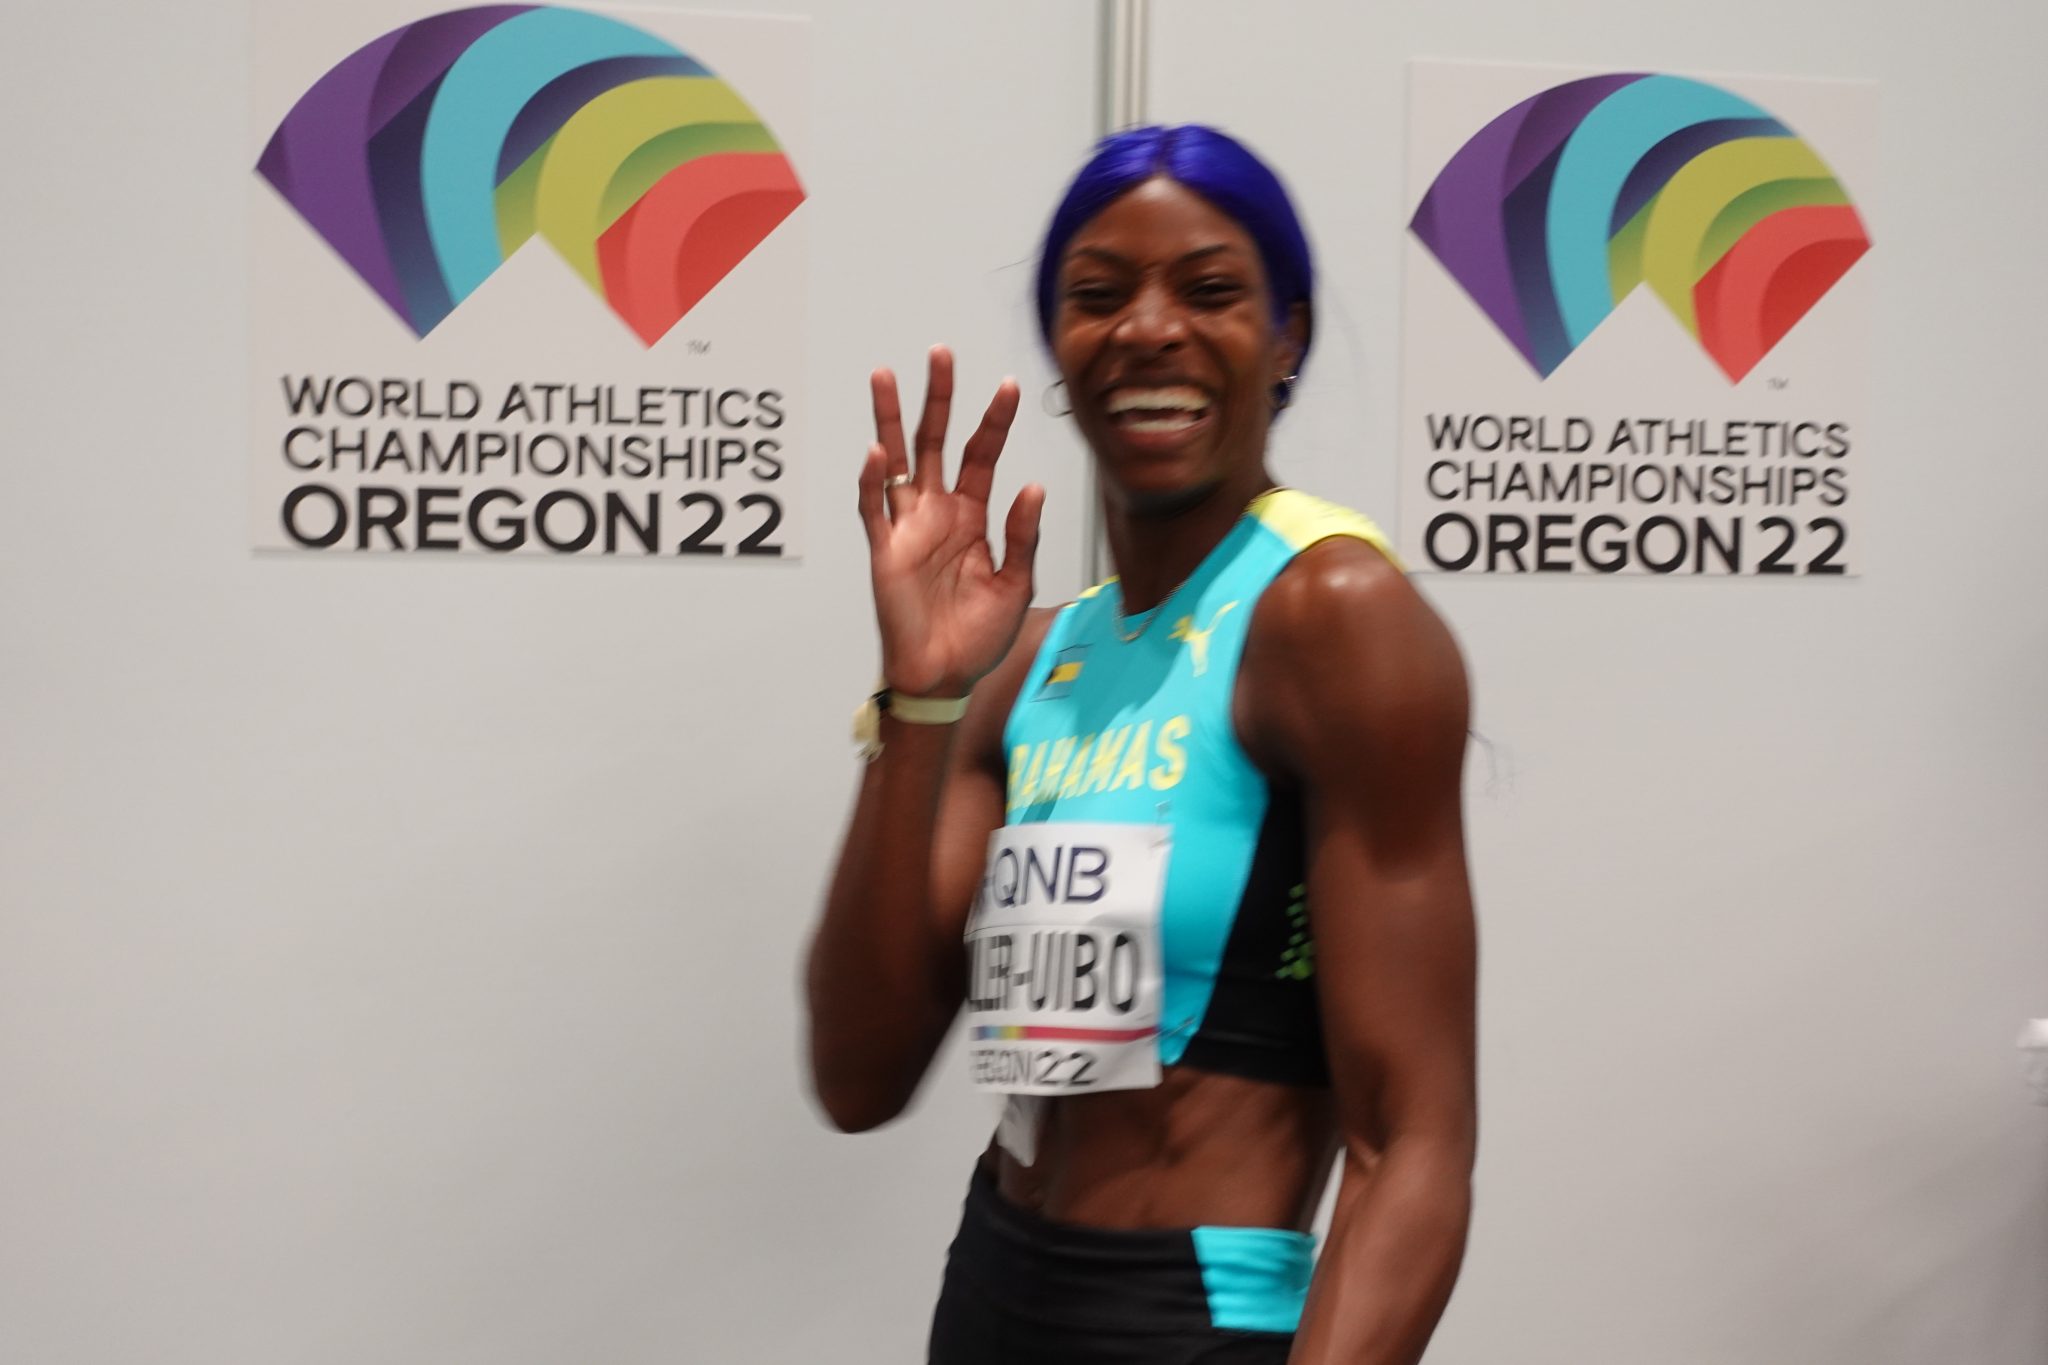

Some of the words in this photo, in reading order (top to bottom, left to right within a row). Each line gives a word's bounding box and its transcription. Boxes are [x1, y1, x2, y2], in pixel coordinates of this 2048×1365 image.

[281, 374, 482, 421] WORLD
[497, 381, 786, 429] ATHLETICS
[282, 426, 786, 481] CHAMPIONSHIPS
[1426, 413, 1594, 453] WORLD
[1605, 418, 1851, 459] ATHLETICS
[1426, 460, 1848, 507] CHAMPIONSHIPS
[994, 846, 1109, 907] QNB
